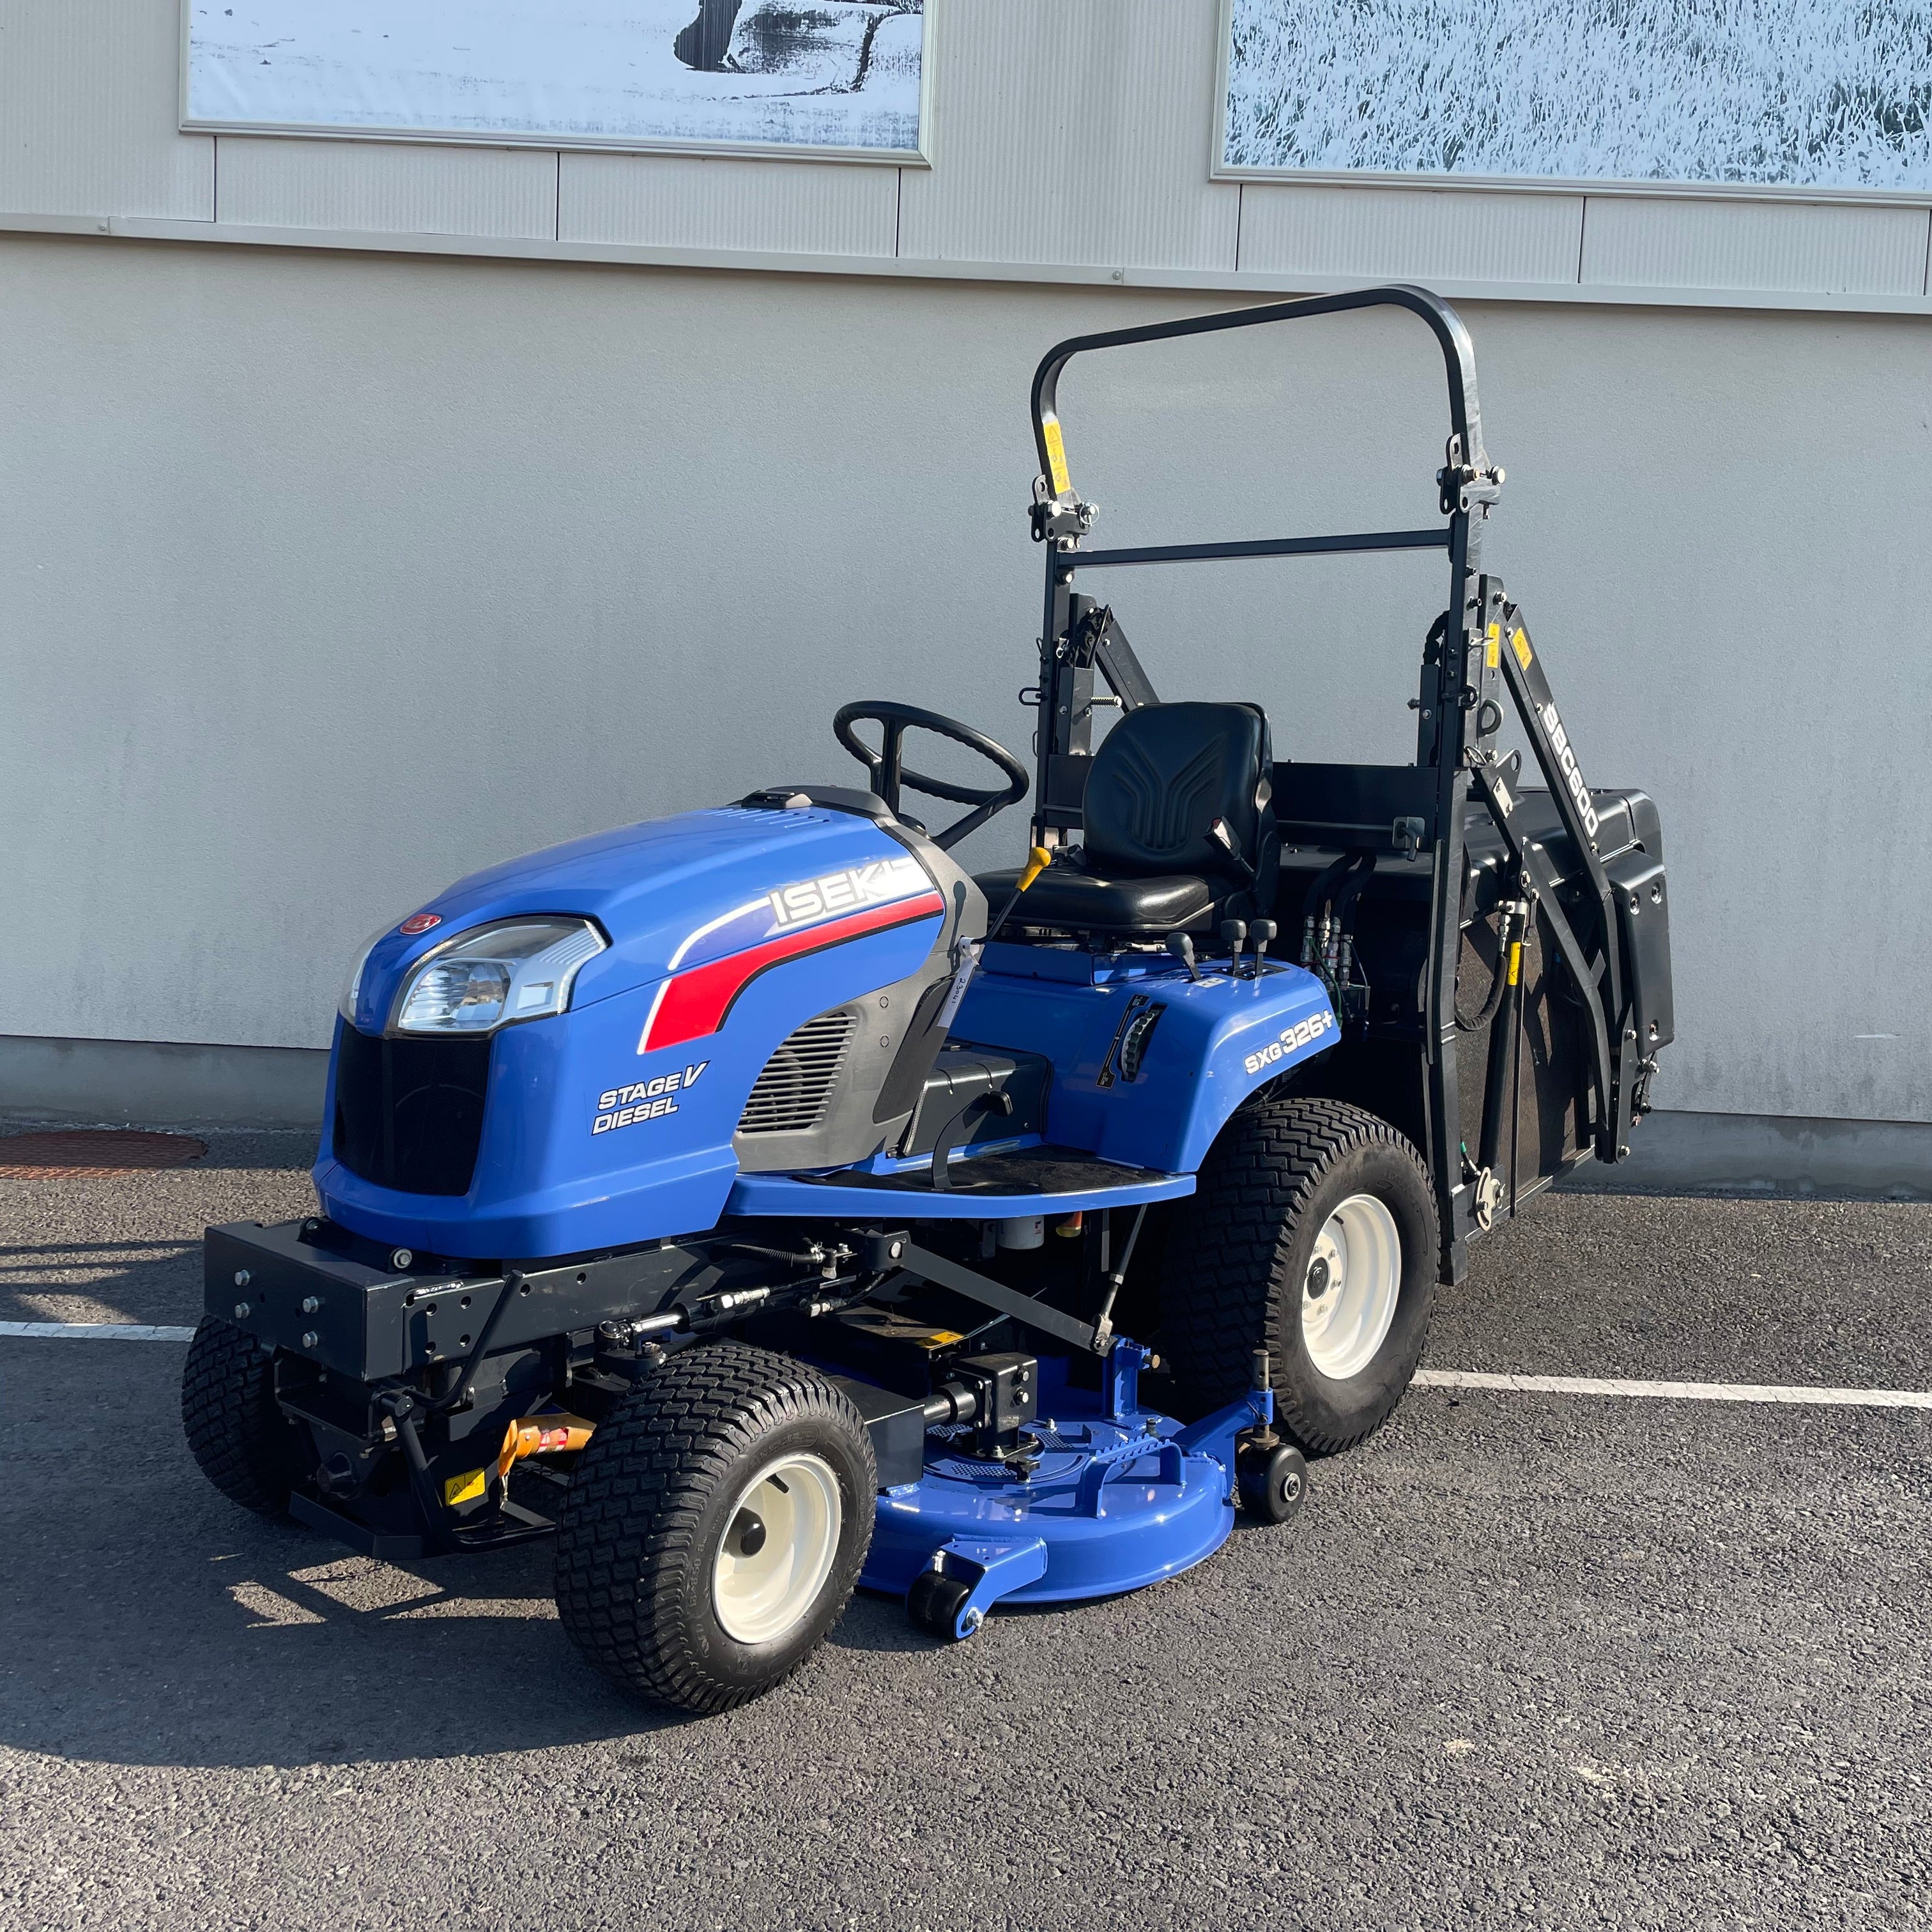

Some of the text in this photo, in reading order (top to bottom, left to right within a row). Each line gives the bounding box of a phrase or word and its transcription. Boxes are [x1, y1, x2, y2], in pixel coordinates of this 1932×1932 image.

[1244, 1009, 1333, 1075] SXG 326+
[597, 1060, 711, 1111] STAGE V
[591, 1096, 680, 1136] DIESEL
